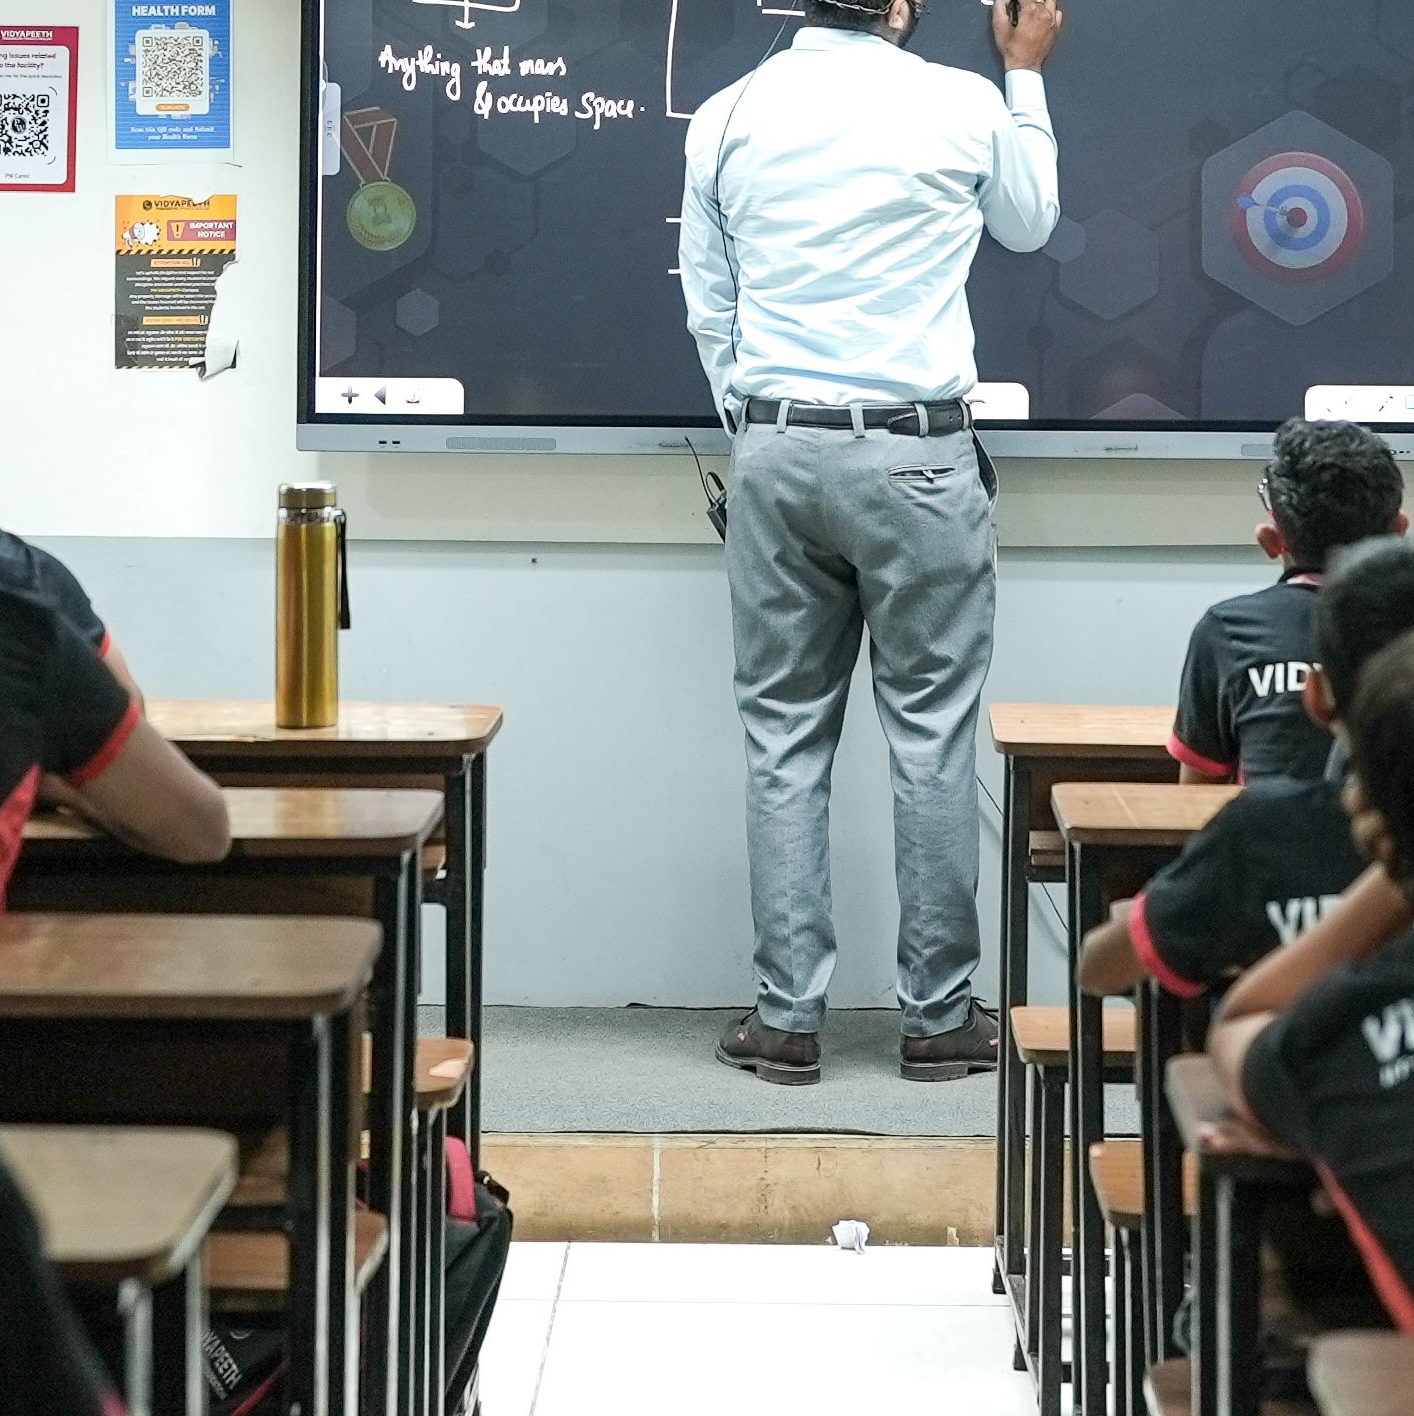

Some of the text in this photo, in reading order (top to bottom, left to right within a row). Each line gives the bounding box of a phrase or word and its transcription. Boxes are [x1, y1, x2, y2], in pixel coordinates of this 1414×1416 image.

[132, 5, 216, 17] HEALTH FORM
[1, 30, 53, 38] VIDYAPEETH
[378, 44, 461, 101] Anything
[471, 45, 511, 77] that
[496, 91, 568, 123] occupies
[1248, 661, 1323, 698] VID
